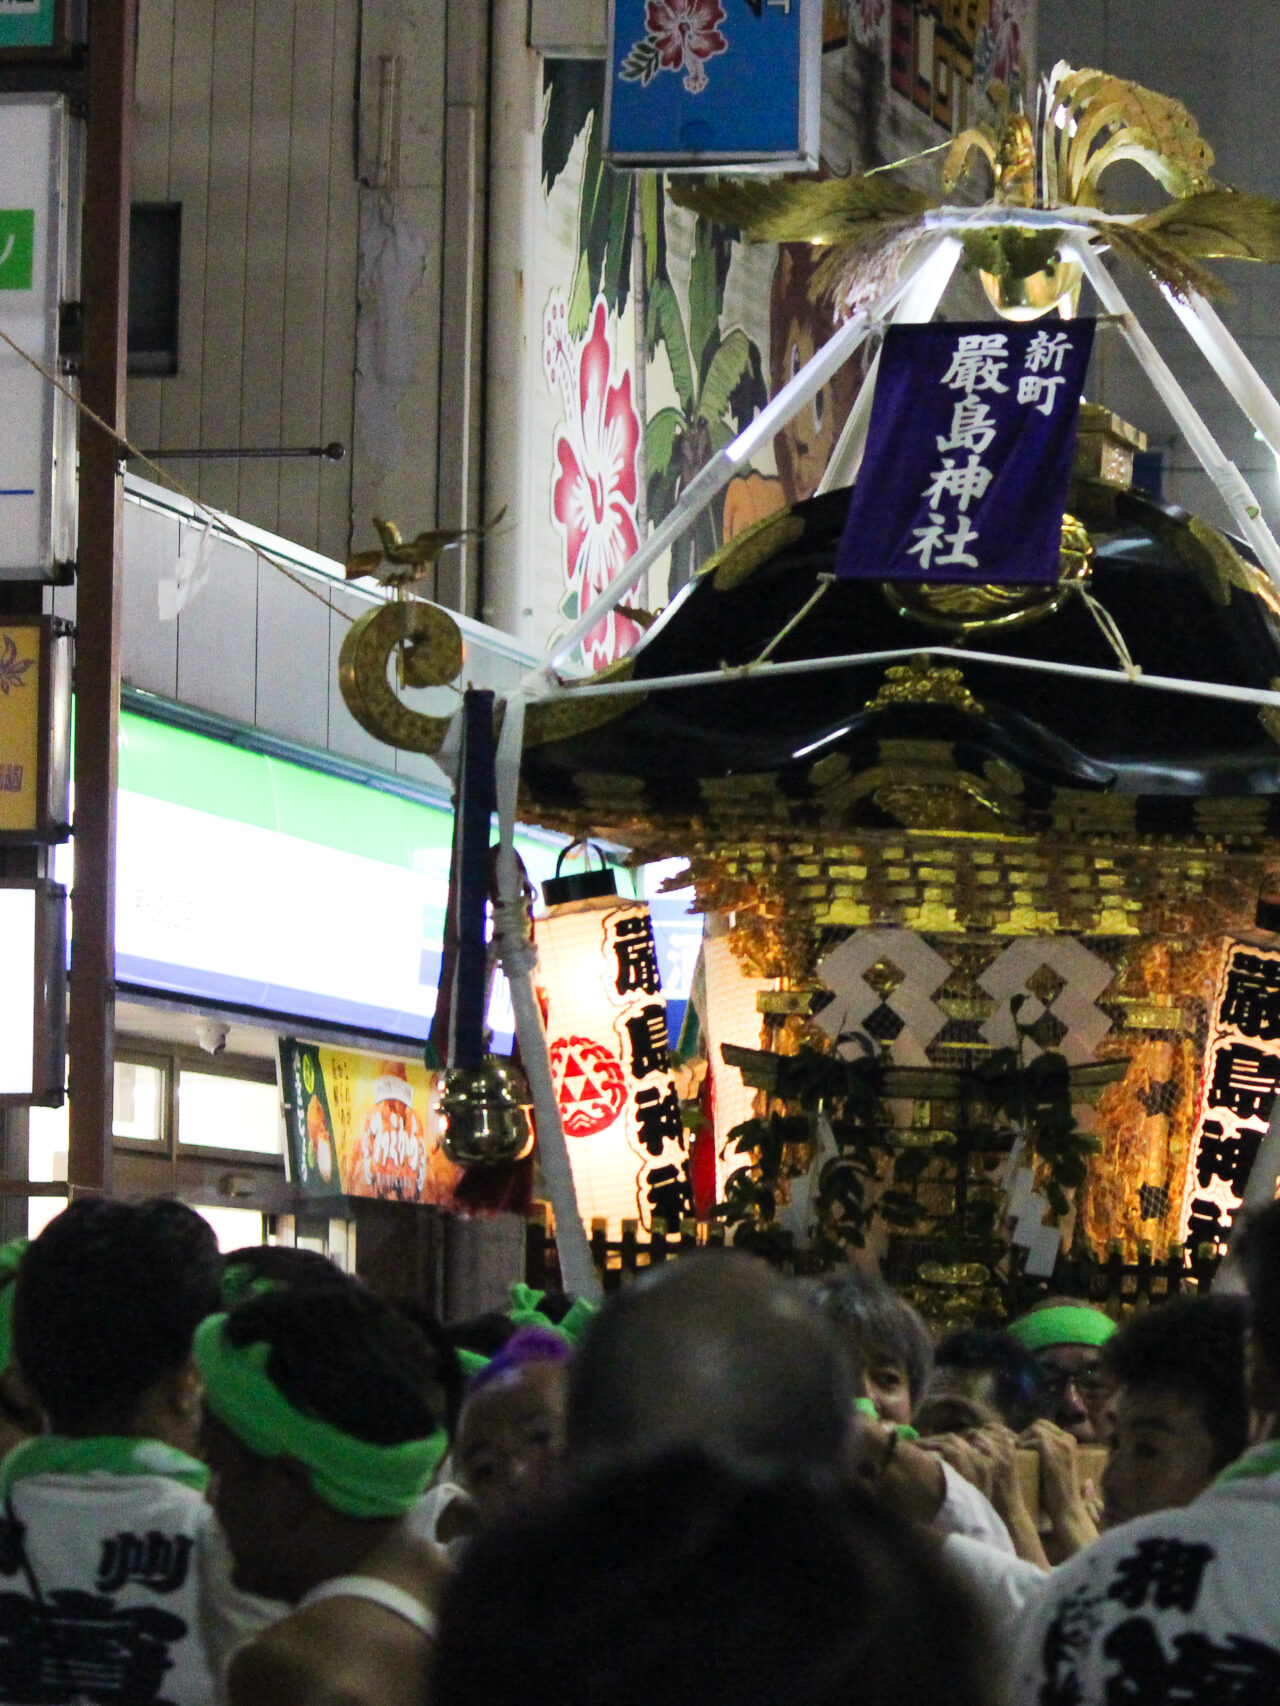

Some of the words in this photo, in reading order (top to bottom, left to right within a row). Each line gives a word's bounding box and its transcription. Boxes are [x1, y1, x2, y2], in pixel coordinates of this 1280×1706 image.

[906, 334, 1010, 570] 嚴島神社
[1016, 329, 1074, 416] 新町
